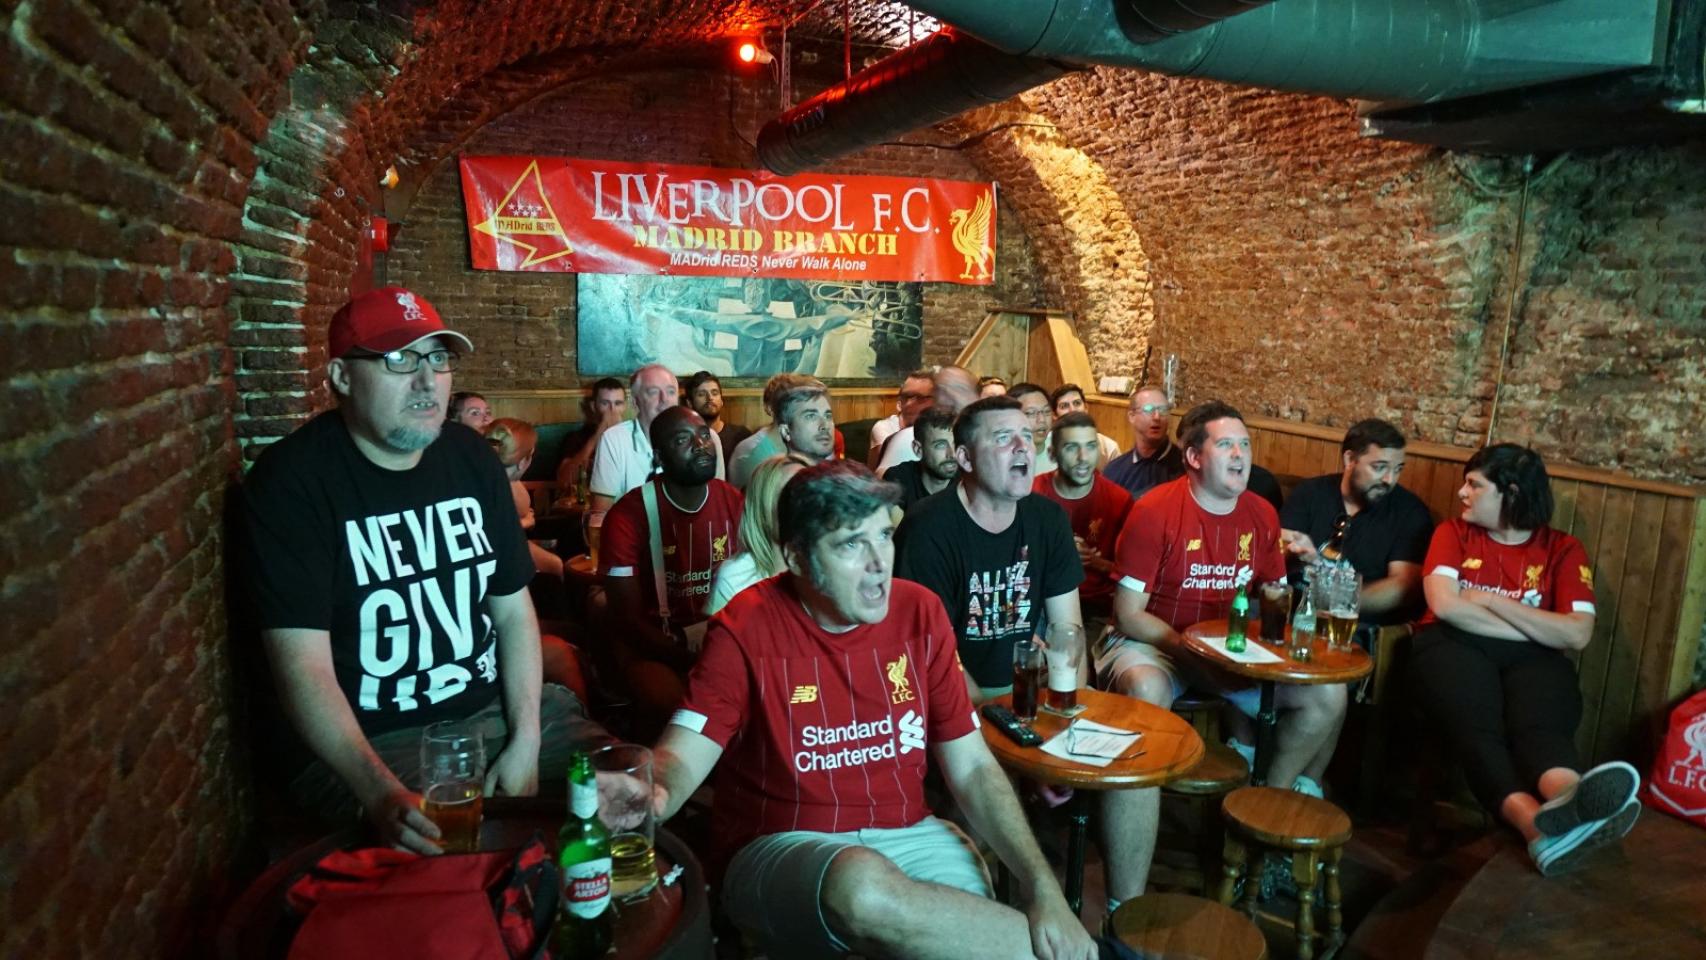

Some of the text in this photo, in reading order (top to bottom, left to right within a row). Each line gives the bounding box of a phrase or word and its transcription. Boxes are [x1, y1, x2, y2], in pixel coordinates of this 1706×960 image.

[592, 171, 940, 234] LIVERPOOL F.C.
[633, 225, 898, 256] MADRID BRANCH
[670, 251, 867, 271] MADrid REDS Never Walk Alone
[345, 496, 494, 587] NEVER
[801, 714, 893, 747] Standard
[794, 738, 896, 772] Chartered
